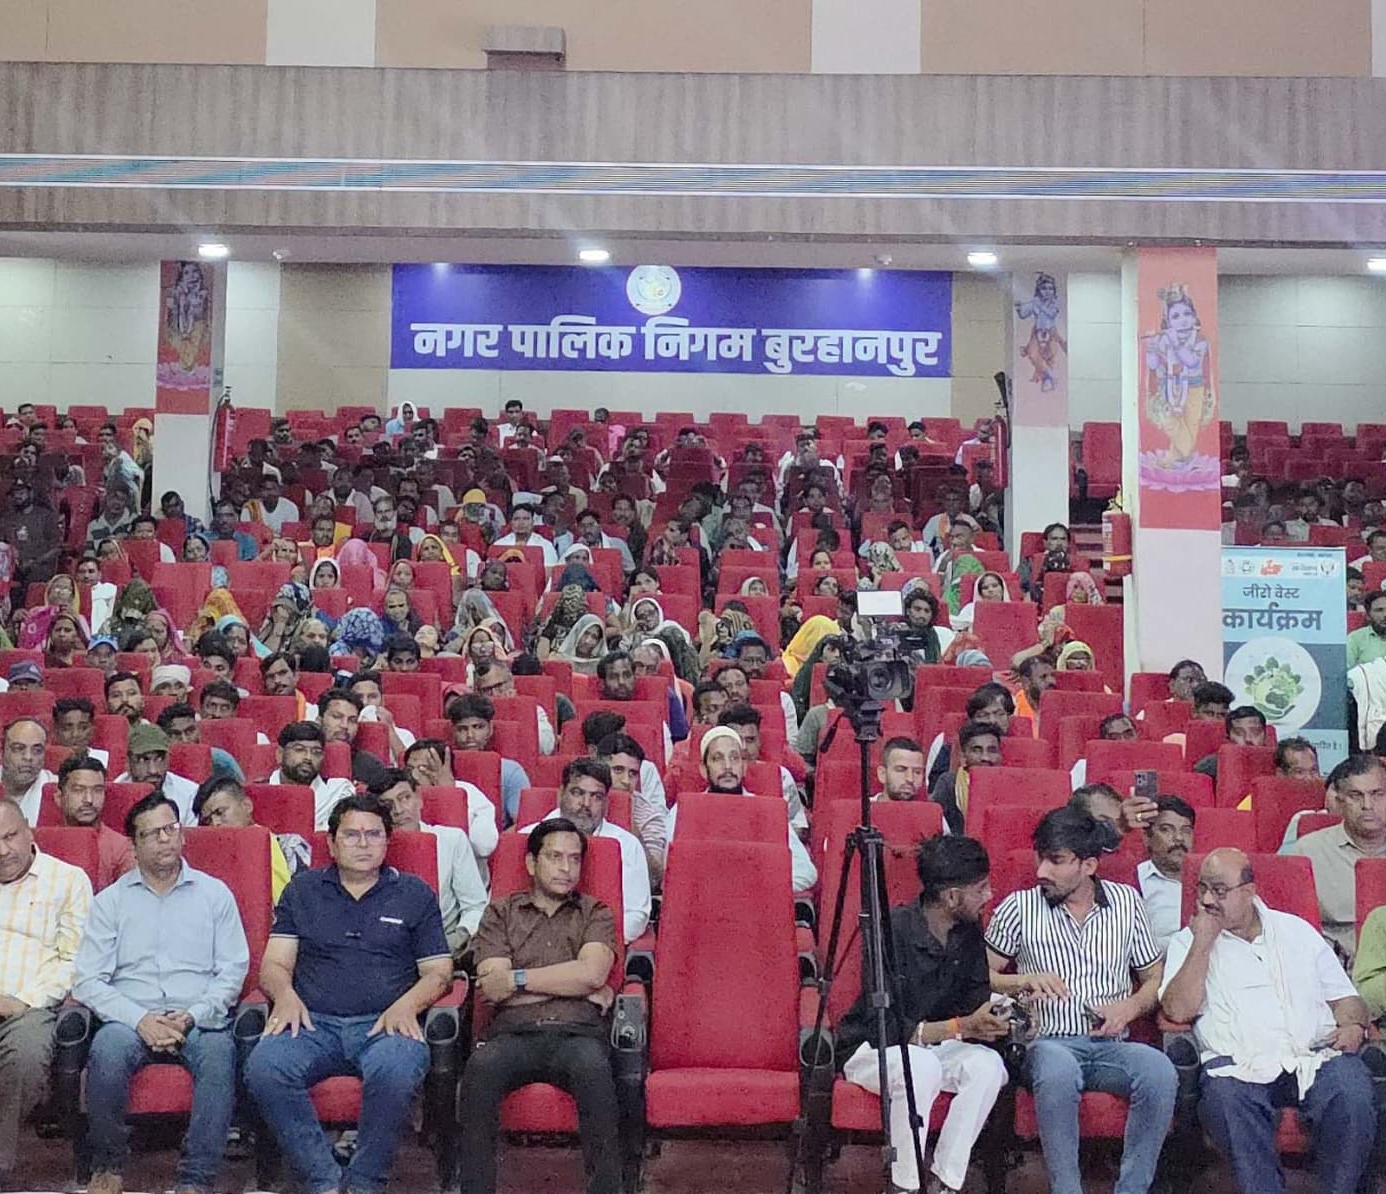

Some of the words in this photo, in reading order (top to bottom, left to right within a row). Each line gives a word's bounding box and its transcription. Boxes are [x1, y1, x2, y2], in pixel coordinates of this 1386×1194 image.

[410, 323, 502, 358] नगर
[508, 315, 636, 360] पालिक
[640, 316, 756, 361] निगम
[762, 328, 943, 375] बुरहानपुर
[1242, 584, 1271, 599] जीरो
[1274, 584, 1300, 599] वेस्ट
[1221, 601, 1323, 631] कार्यक्रम
